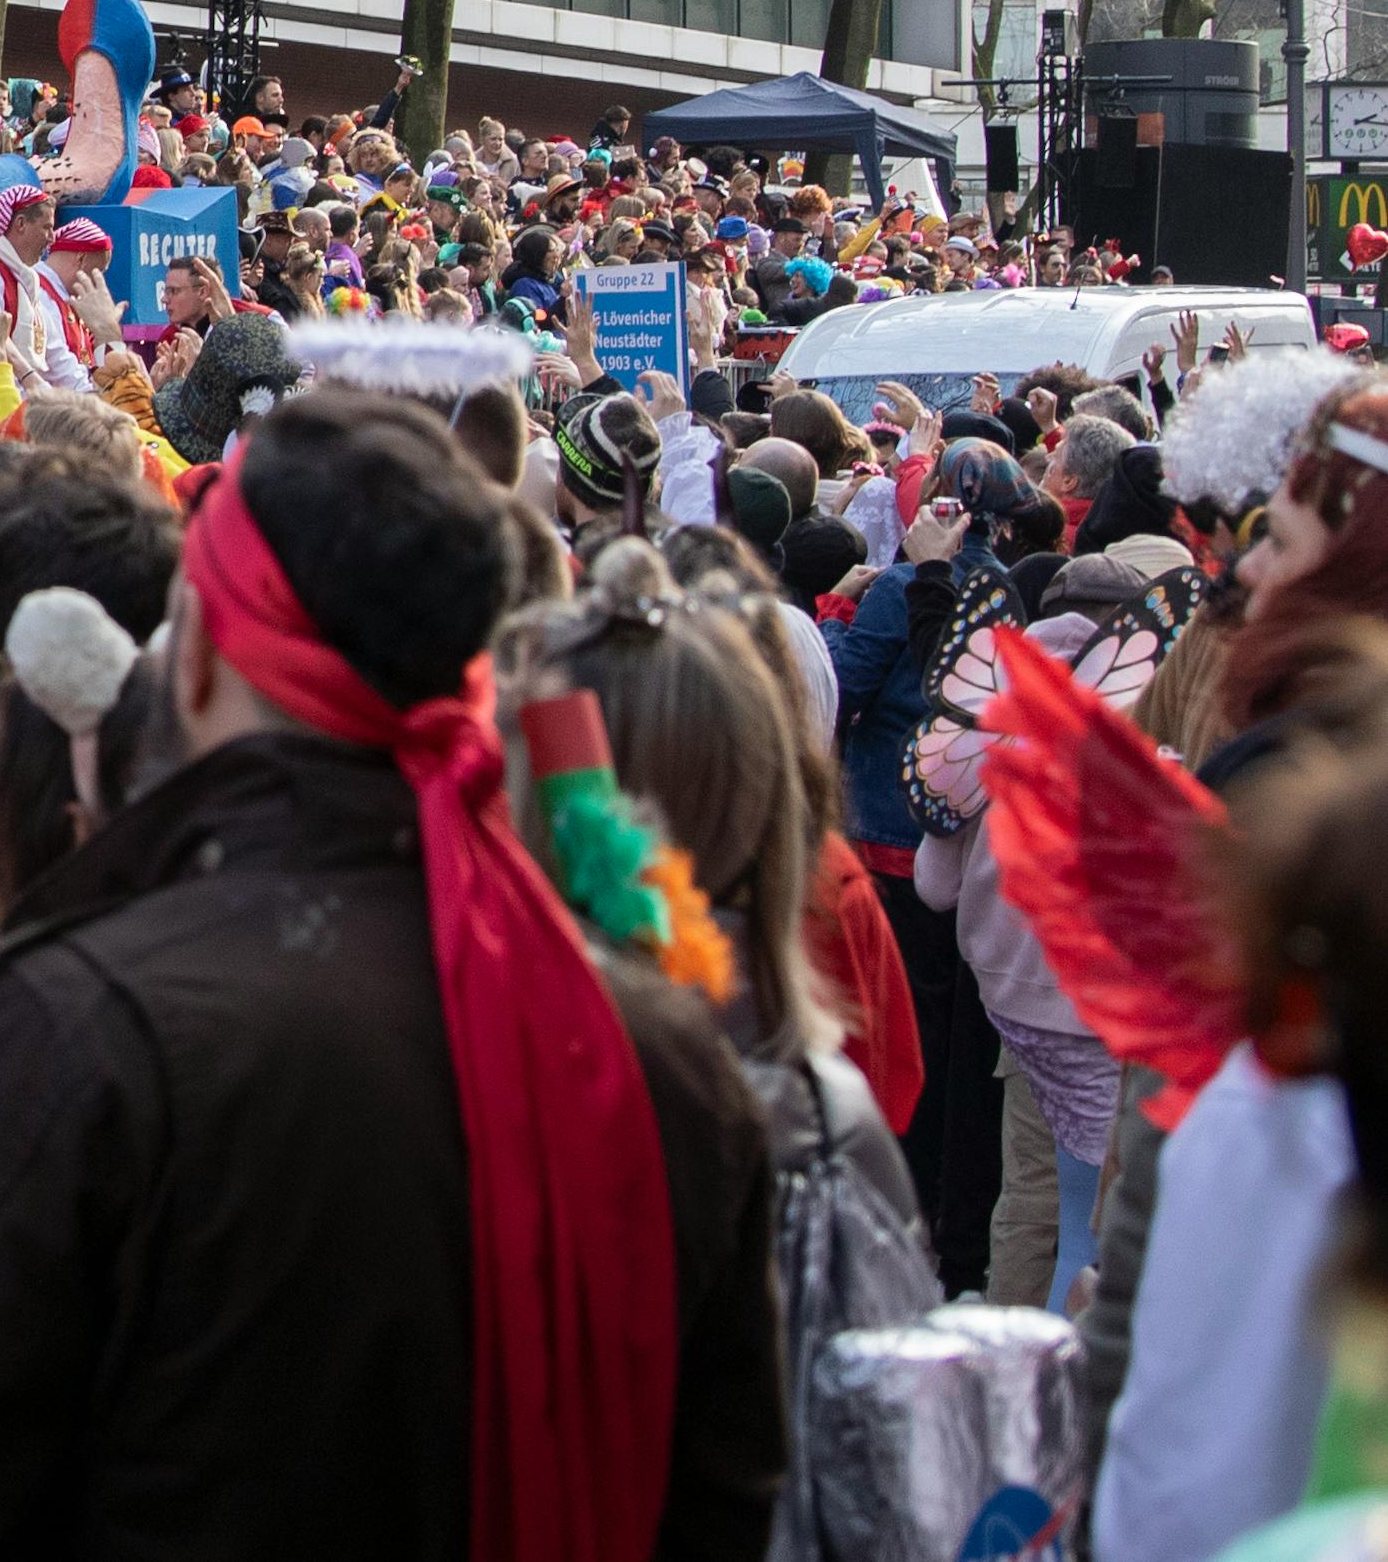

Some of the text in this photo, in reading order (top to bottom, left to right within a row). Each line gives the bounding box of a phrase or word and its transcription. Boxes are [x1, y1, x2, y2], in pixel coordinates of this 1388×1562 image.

[139, 232, 217, 267] RECHTER
[596, 272, 655, 289] Gruppe 22
[603, 309, 672, 326] Lövenicher
[594, 331, 663, 348] Neustädter
[601, 355, 656, 370] 1903 e.V.
[556, 430, 592, 477] CARRERA
